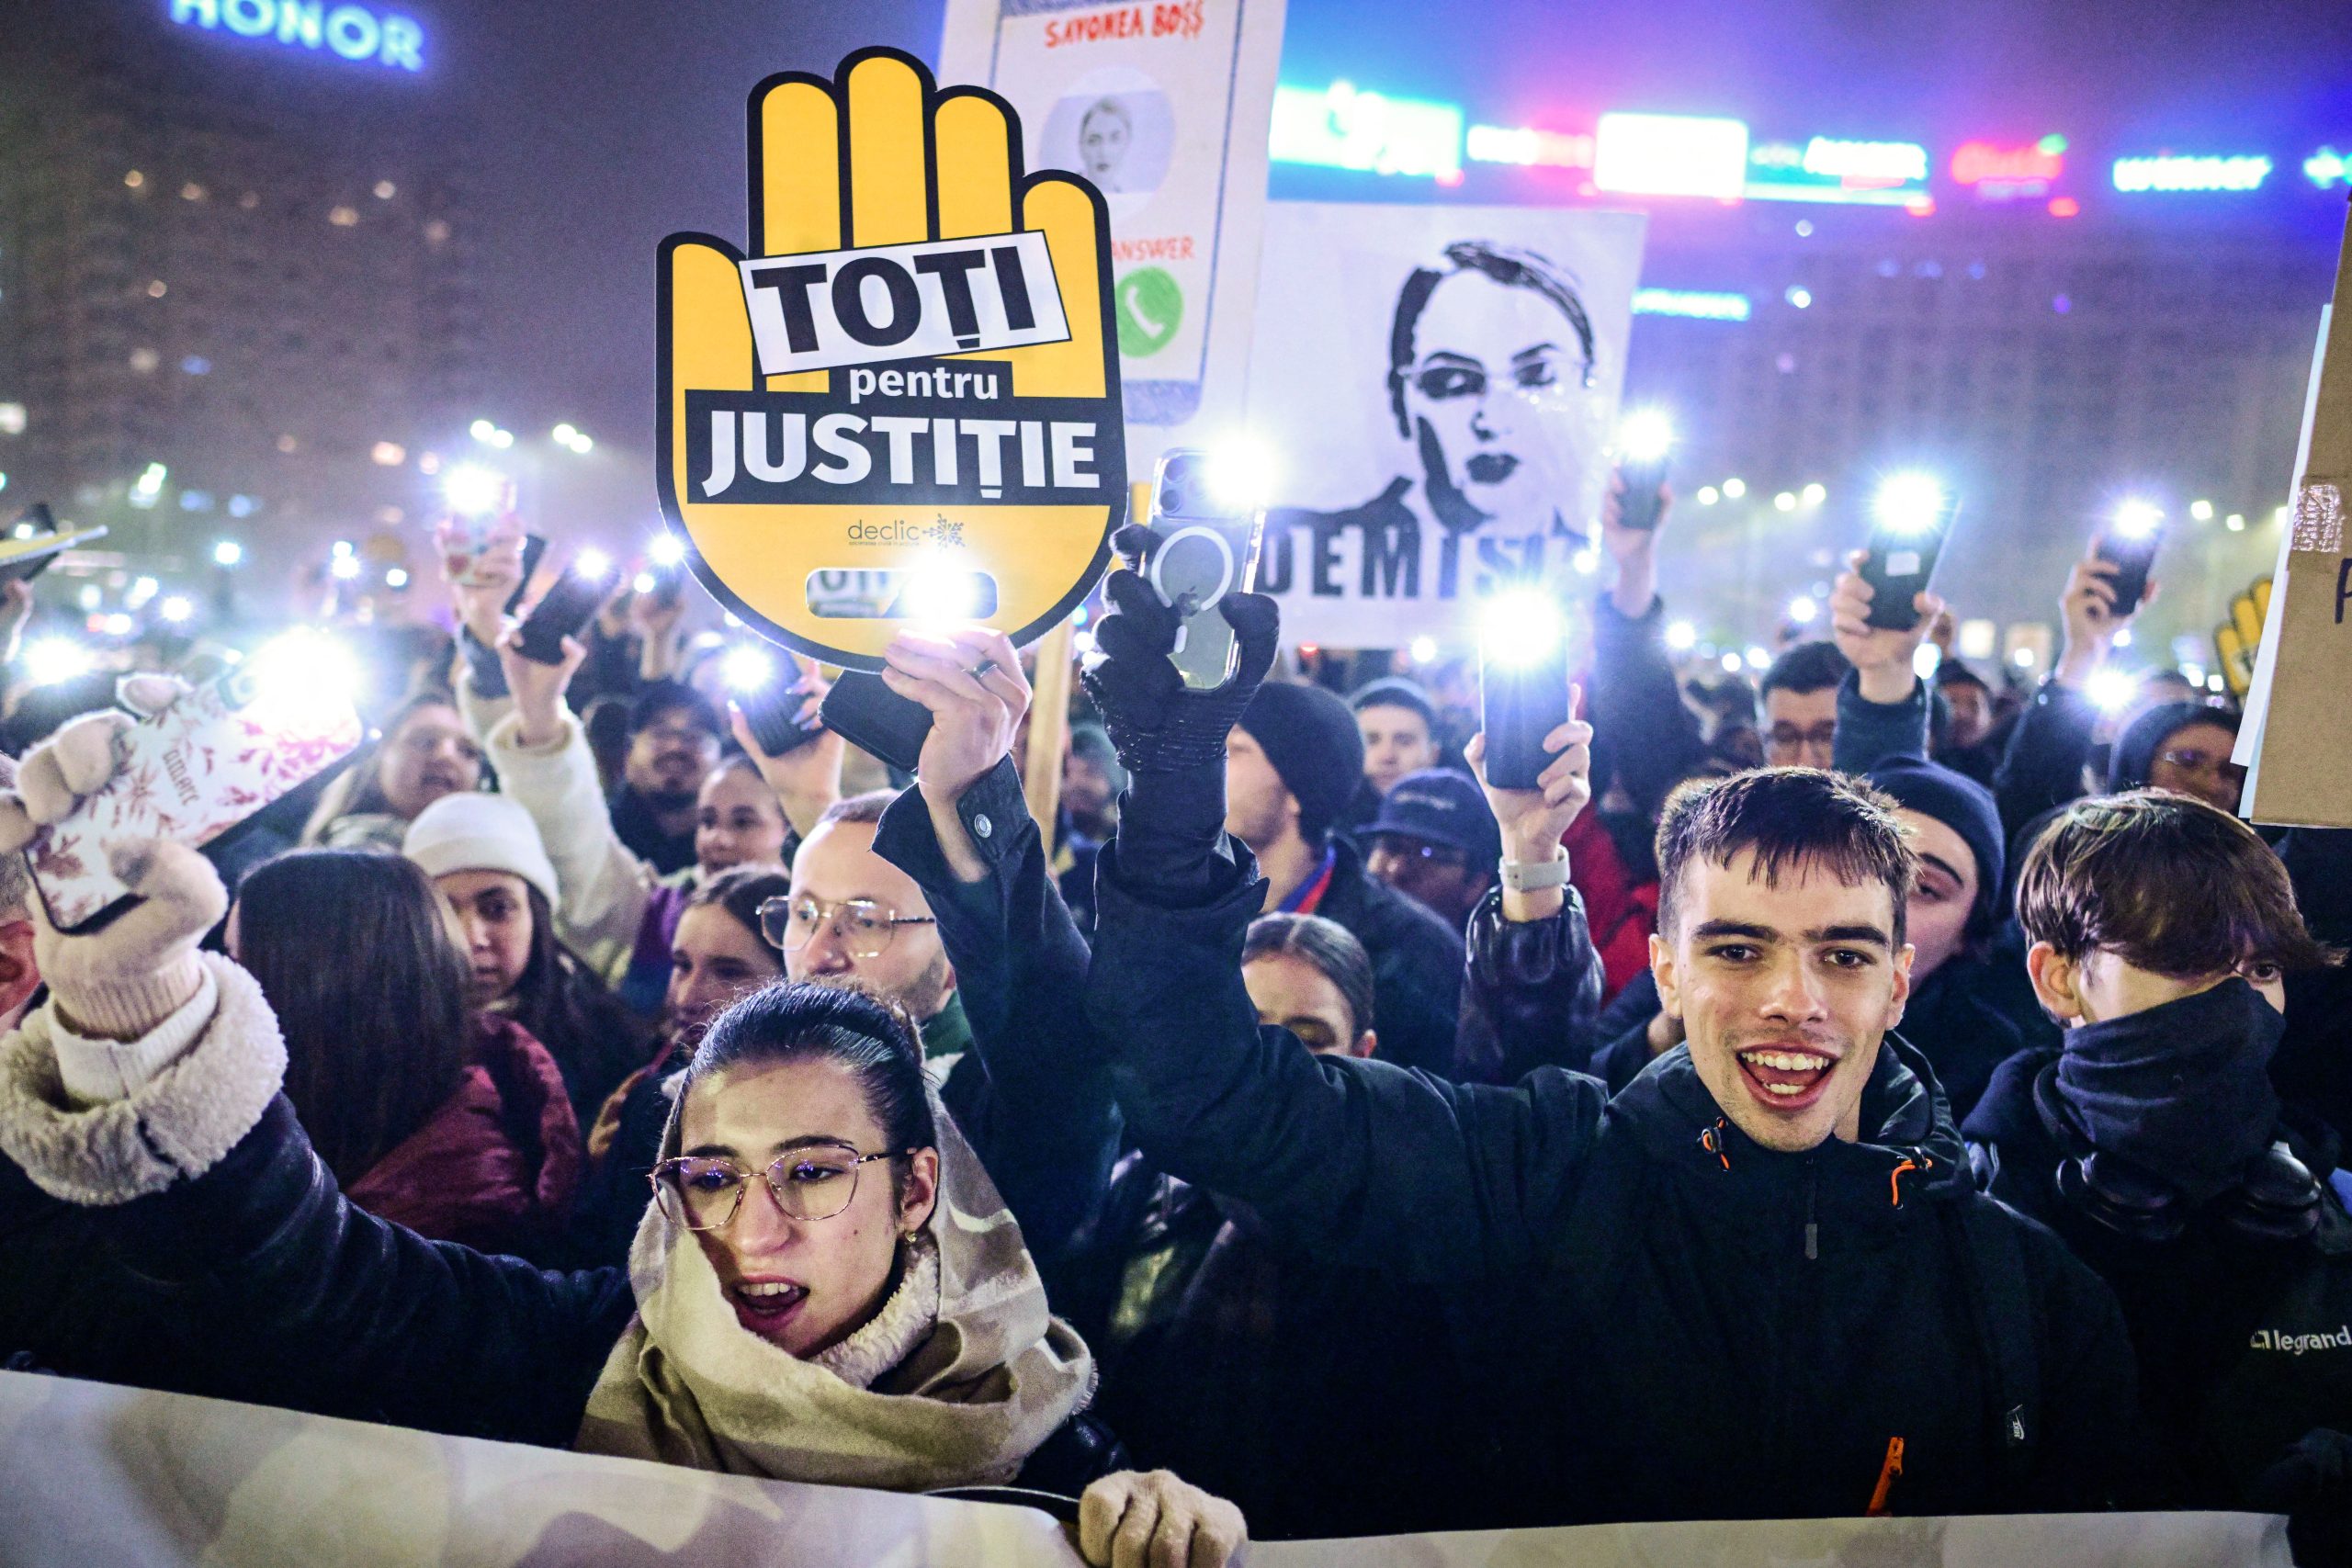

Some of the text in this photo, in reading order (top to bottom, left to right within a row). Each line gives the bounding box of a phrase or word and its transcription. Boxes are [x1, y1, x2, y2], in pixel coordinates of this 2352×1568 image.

[171, 0, 423, 72] HONOR
[752, 245, 1036, 349] TOȚI
[850, 367, 999, 403] pentru
[701, 411, 1101, 499] JUSTIȚIE
[848, 519, 919, 540] declic
[1253, 525, 1594, 599] DEMISI
[2274, 1325, 2352, 1356] legrand
